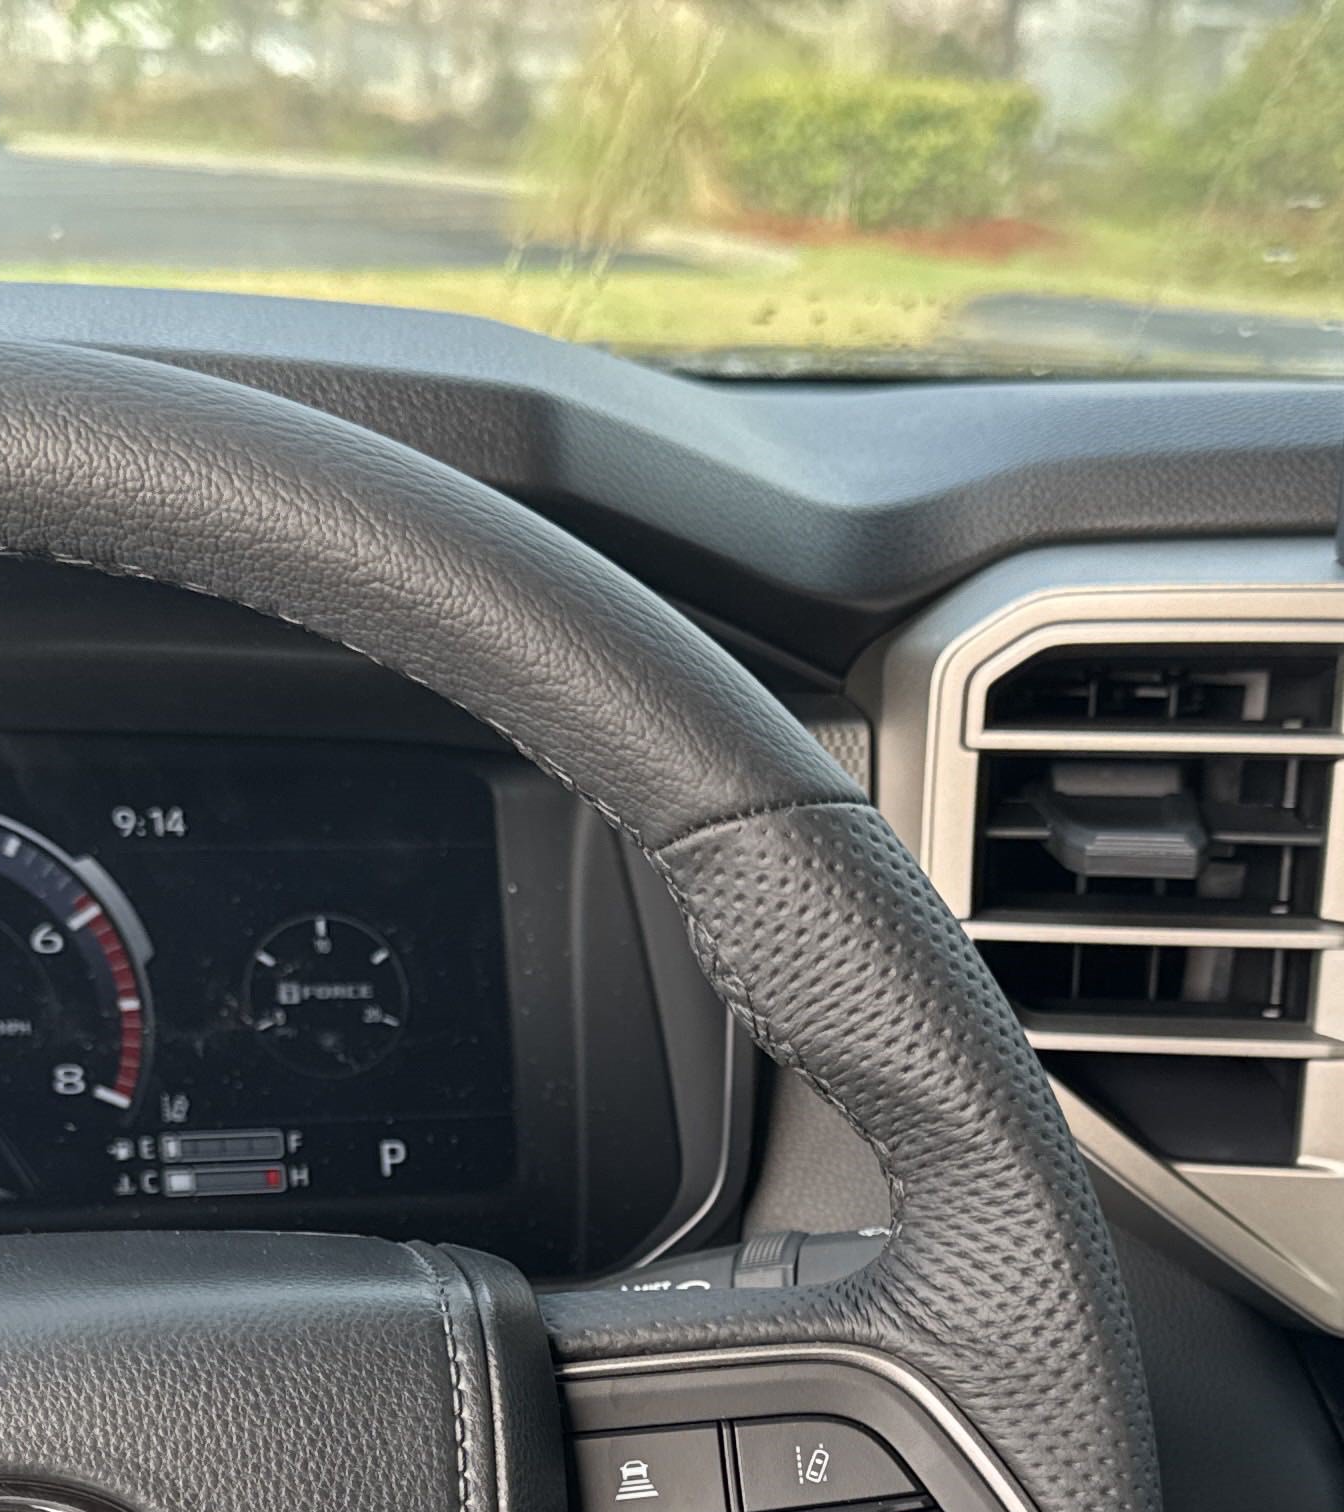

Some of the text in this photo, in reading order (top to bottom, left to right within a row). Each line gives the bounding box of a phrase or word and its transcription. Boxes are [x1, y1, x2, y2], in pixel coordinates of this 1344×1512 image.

[111, 805, 188, 838] 9:14
[30, 923, 64, 954] 6
[53, 1064, 85, 1096] 8
[139, 1136, 155, 1160] E
[286, 1130, 305, 1153] F
[379, 1138, 408, 1177] P
